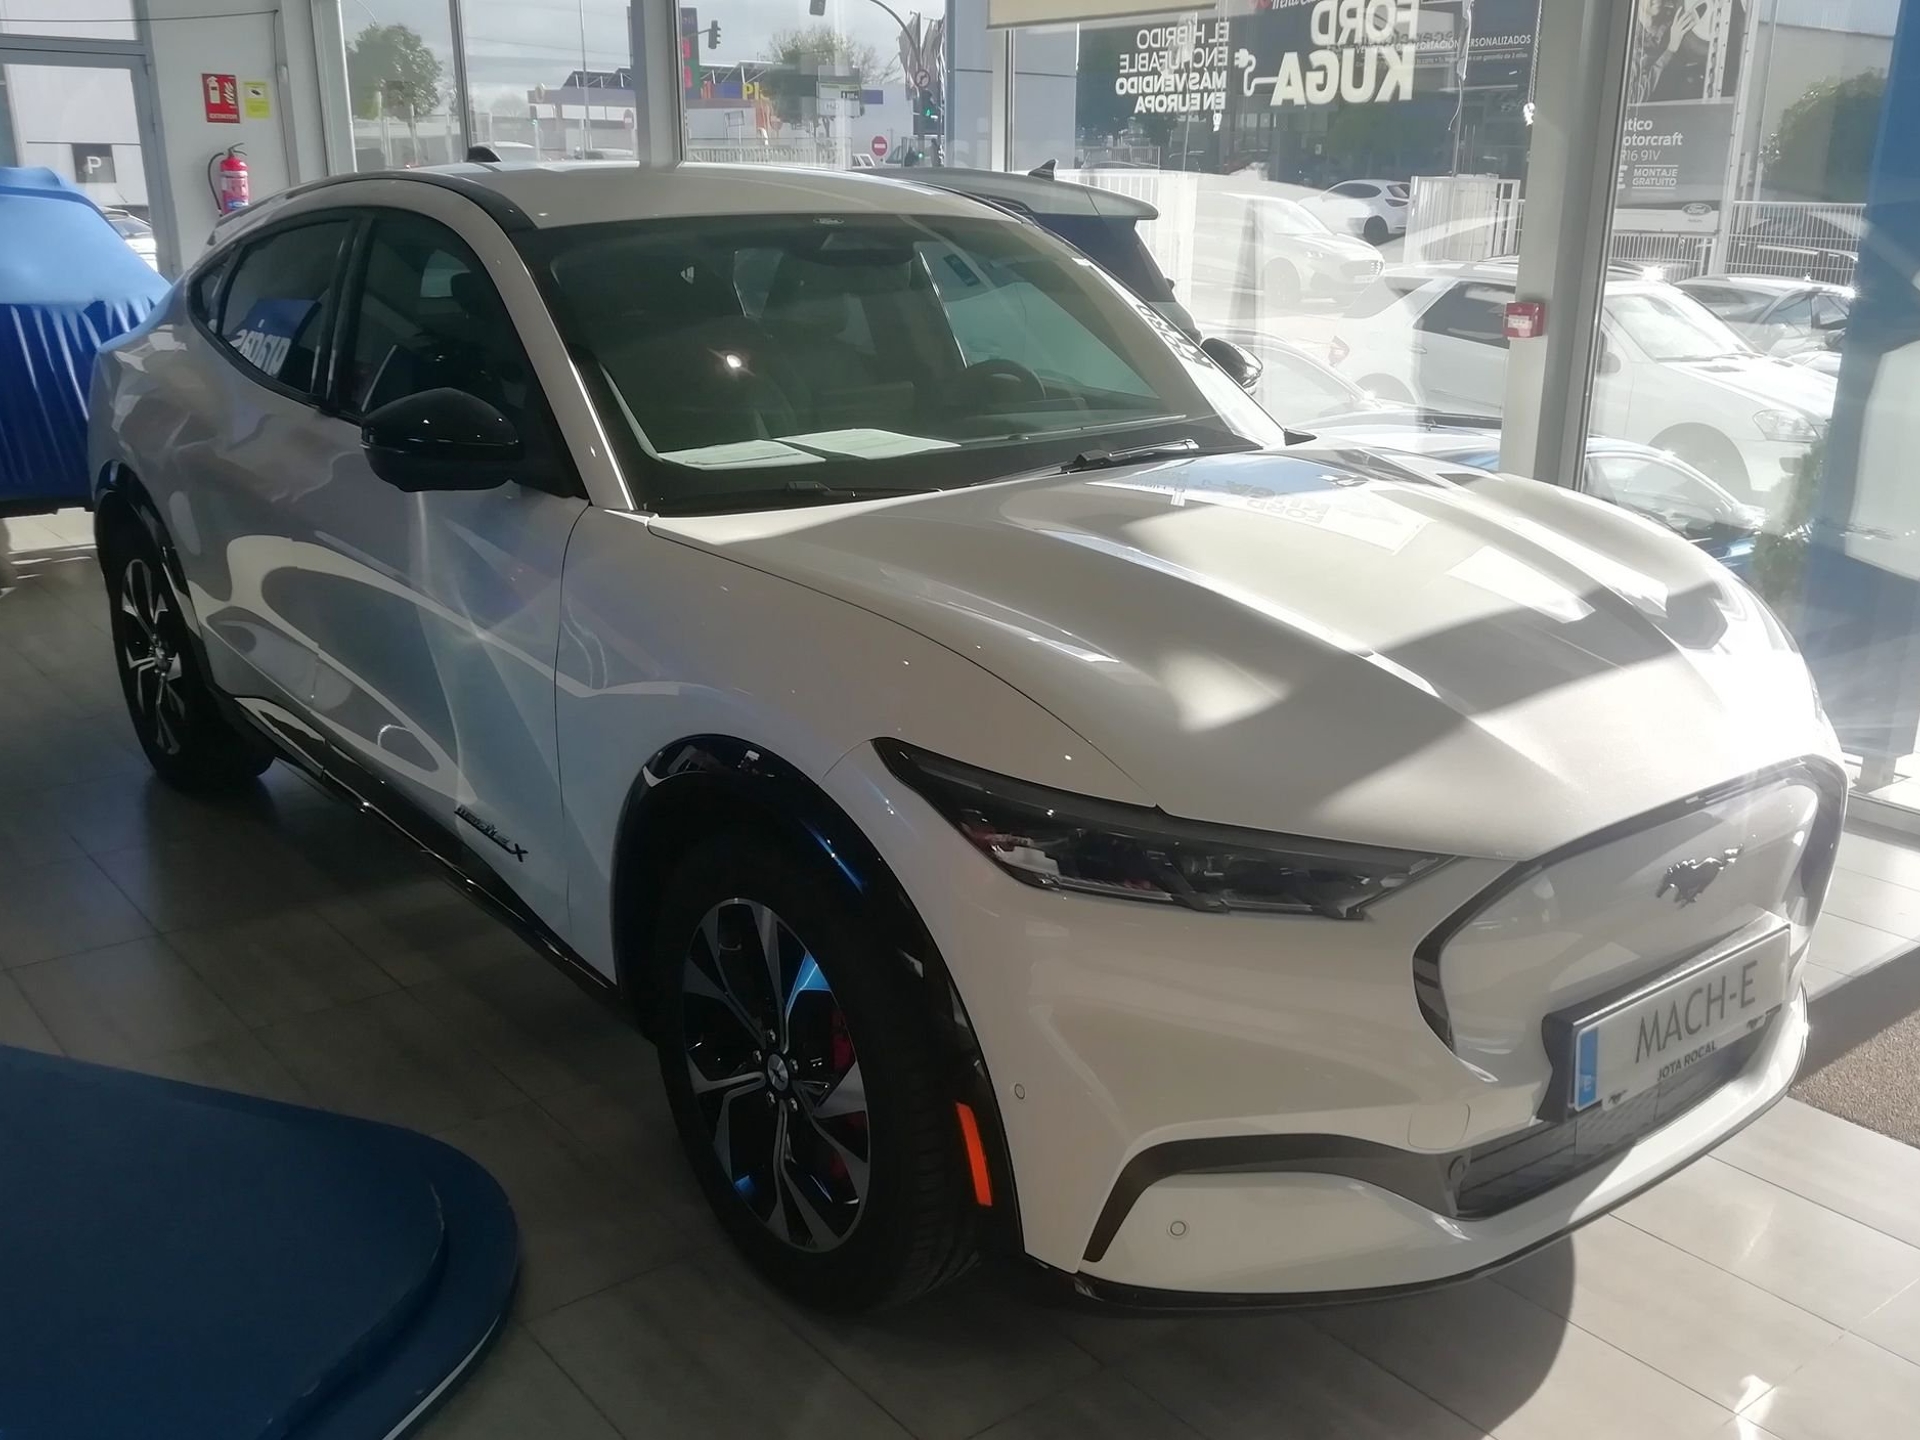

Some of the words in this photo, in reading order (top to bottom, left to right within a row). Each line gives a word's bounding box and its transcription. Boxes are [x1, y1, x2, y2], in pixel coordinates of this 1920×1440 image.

[1467, 35, 1531, 47] ERSONALIZADOS
[1623, 132, 1683, 146] otorcraft
[87, 156, 102, 174] P
[1633, 168, 1678, 177] MONTAJE
[1632, 177, 1677, 186] GRATUITO
[1635, 960, 1758, 1064] MACH-E
[1657, 1055, 1683, 1082] JOTA
[1684, 1040, 1717, 1068] ROCAL
